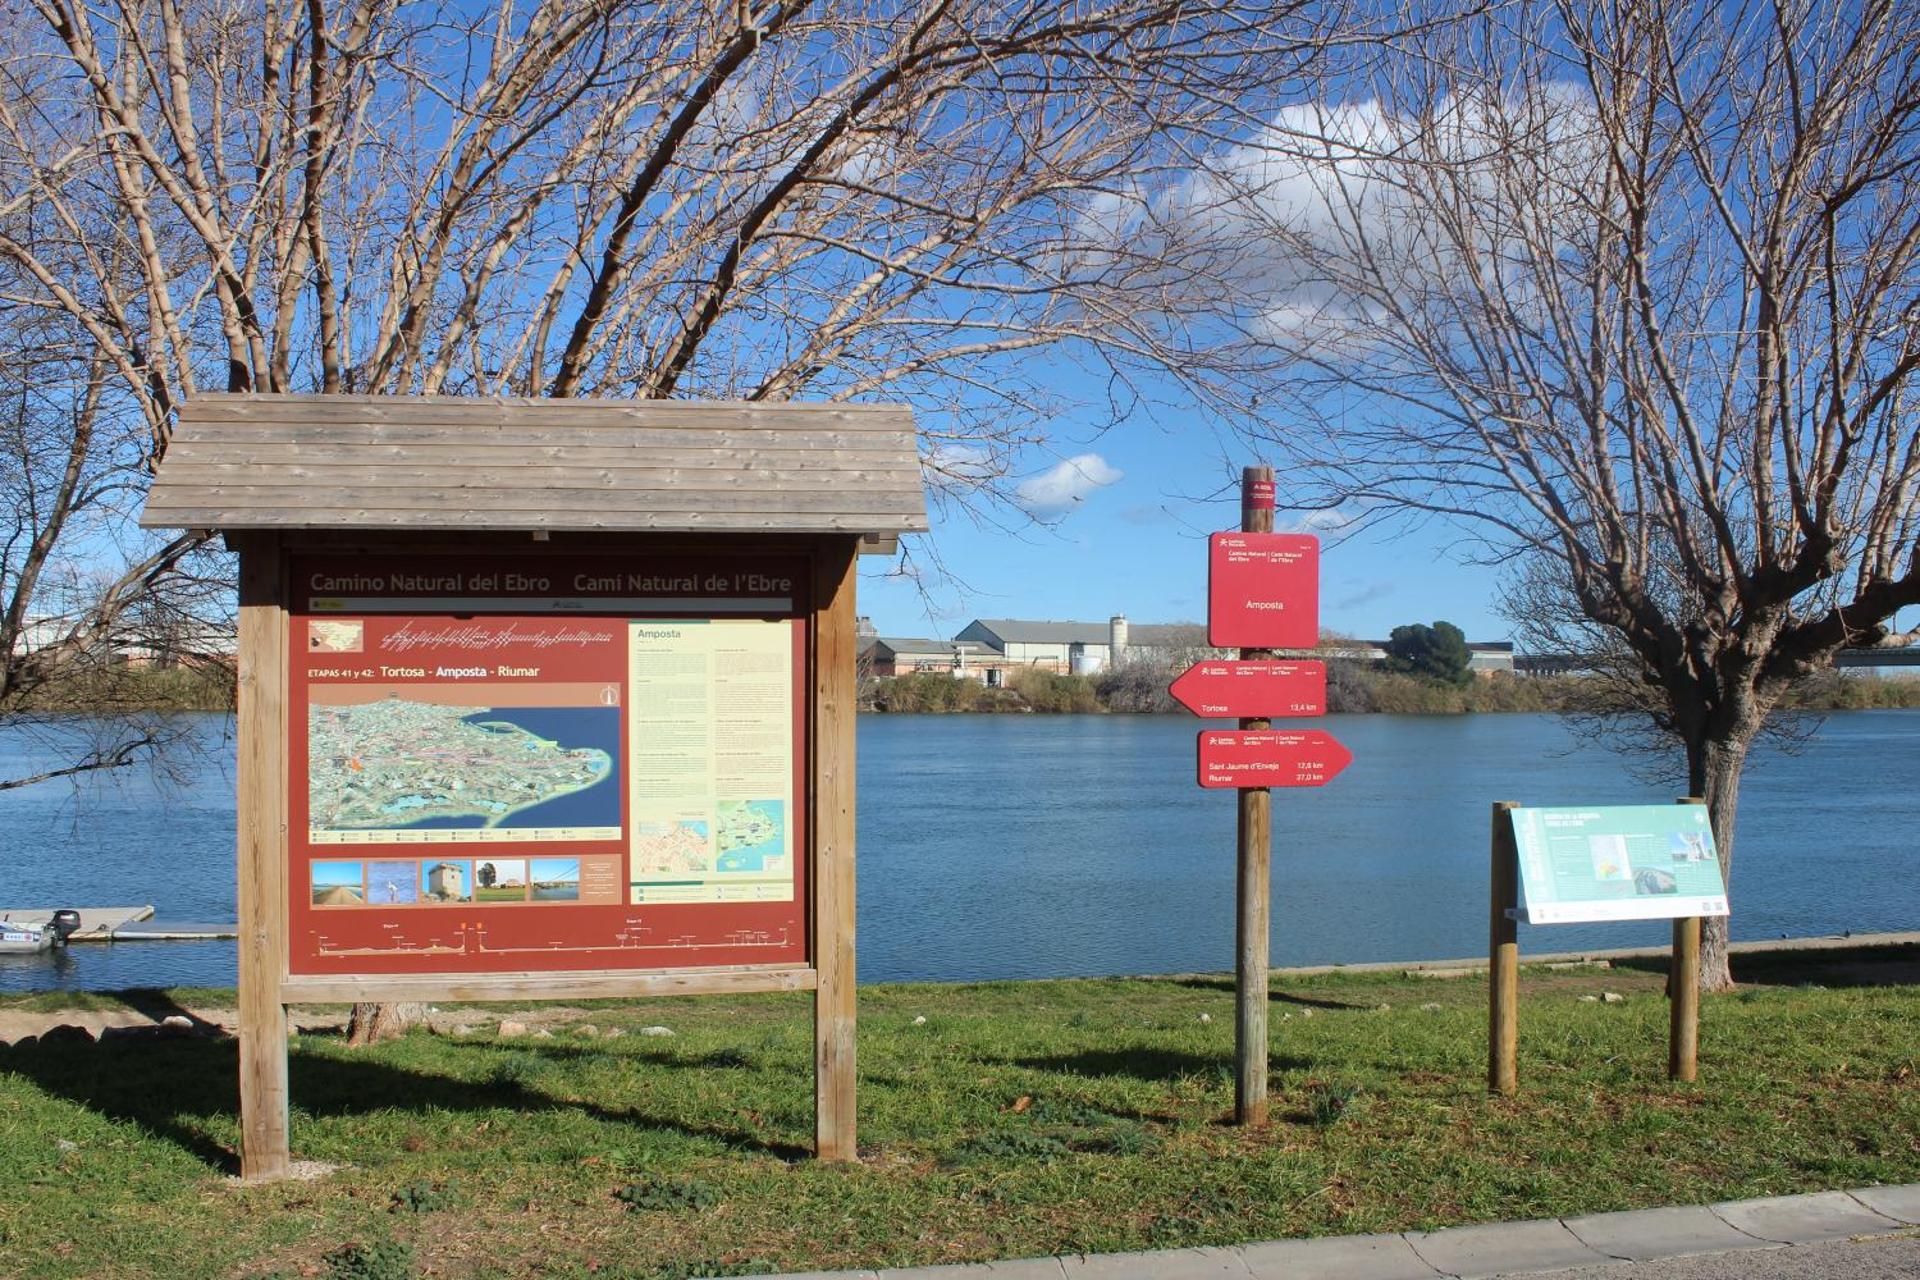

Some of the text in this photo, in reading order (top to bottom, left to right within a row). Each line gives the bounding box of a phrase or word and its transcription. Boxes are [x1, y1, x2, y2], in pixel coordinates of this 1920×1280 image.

[310, 574, 550, 591] Camino Natural del Ebro
[574, 574, 792, 592] Camí Natural de l'Ebre
[1246, 601, 1284, 610] Amposta
[638, 629, 681, 640] Amposta
[308, 669, 340, 678] ETAPAS
[341, 669, 352, 677] 41
[354, 670, 360, 679] y
[380, 666, 424, 678] Tortosa
[436, 666, 486, 679] Amposta
[498, 666, 540, 678] Riumar
